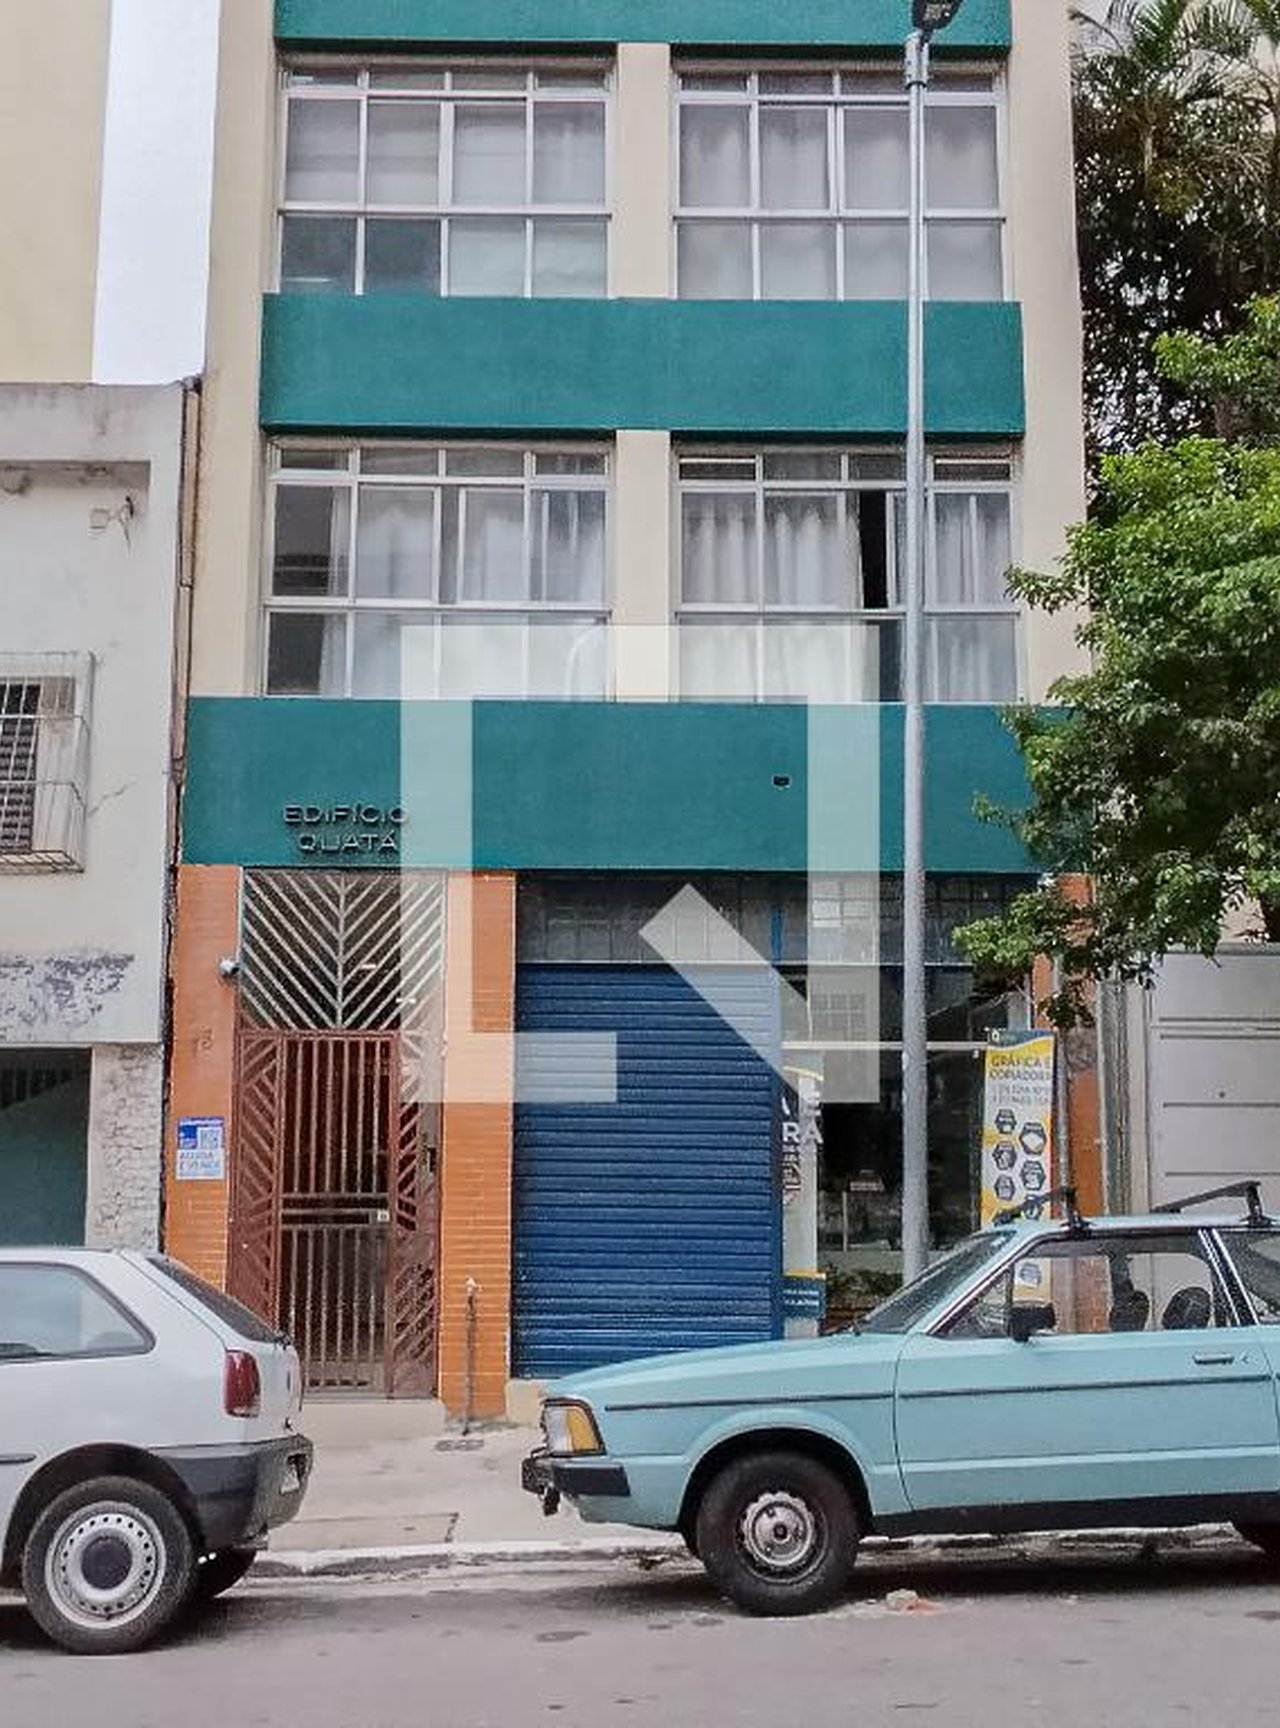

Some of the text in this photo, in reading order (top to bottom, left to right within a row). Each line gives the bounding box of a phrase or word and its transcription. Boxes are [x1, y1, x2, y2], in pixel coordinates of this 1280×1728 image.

[283, 803, 410, 823] EDIFÍCIO
[299, 829, 397, 851] QUATÁ
[991, 1053, 1042, 1068] GRÁFICA
